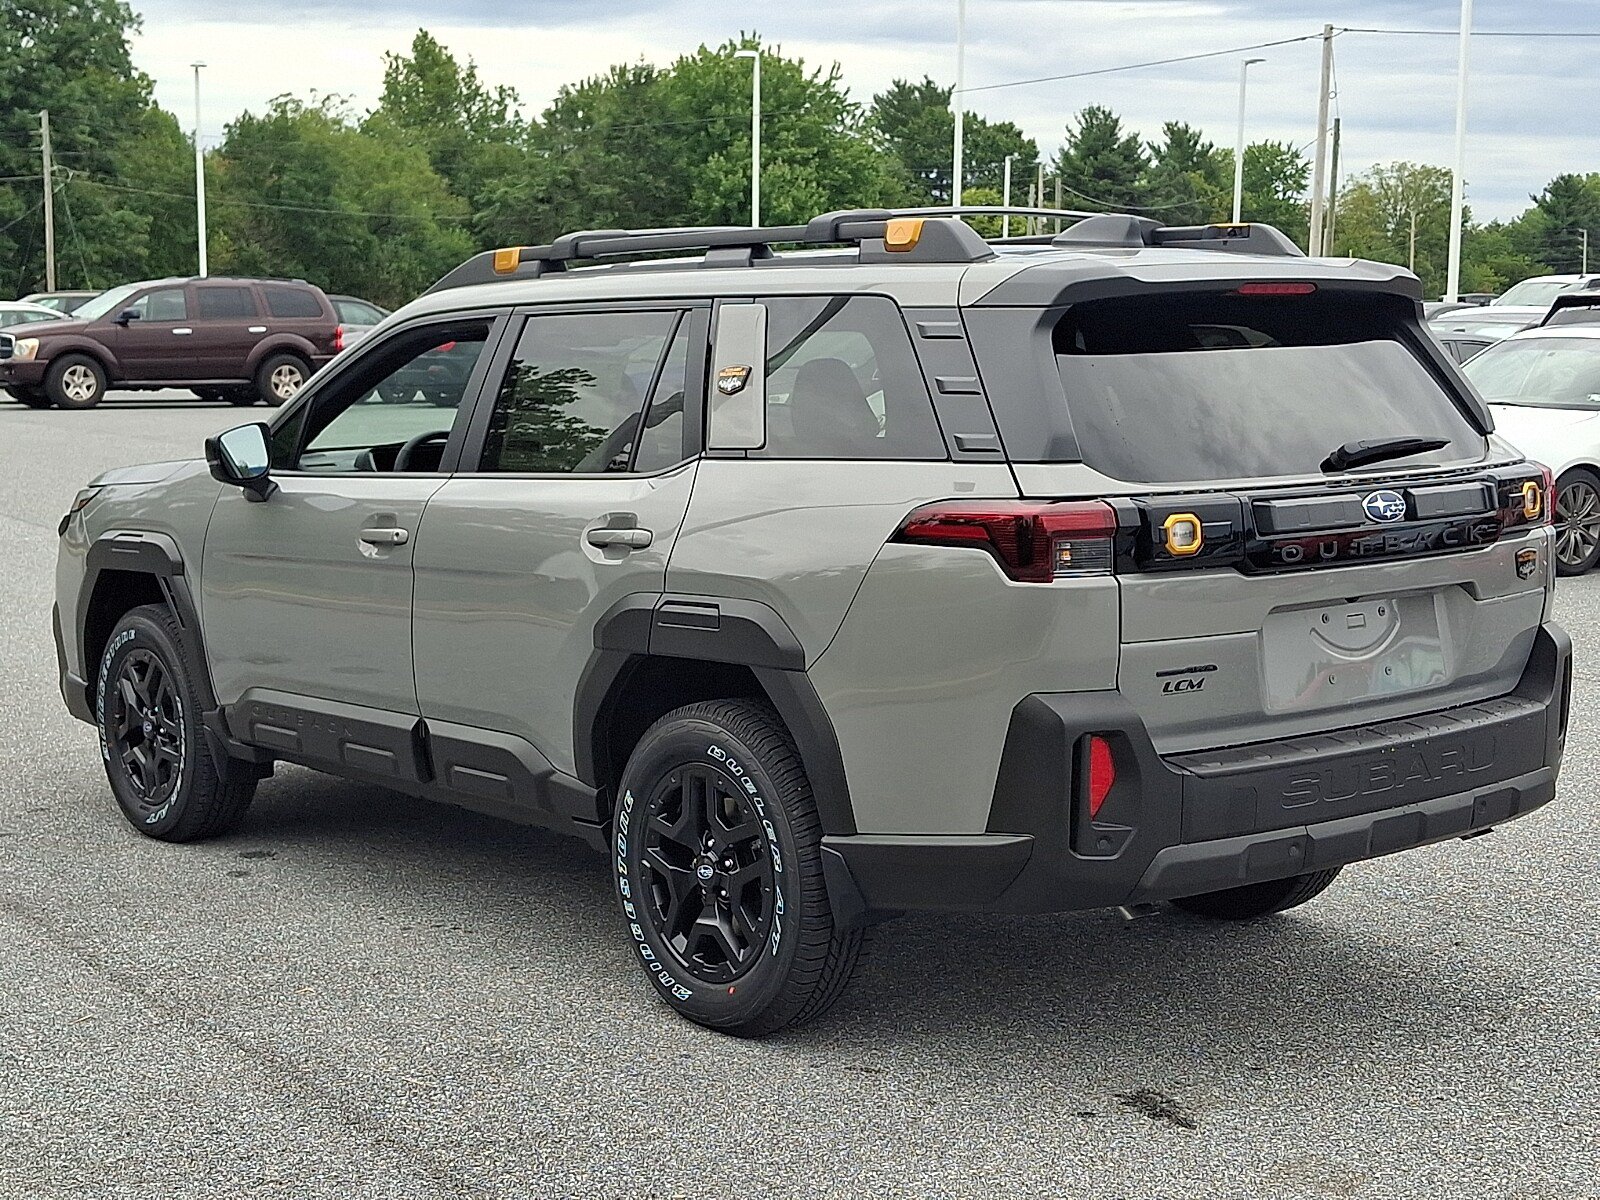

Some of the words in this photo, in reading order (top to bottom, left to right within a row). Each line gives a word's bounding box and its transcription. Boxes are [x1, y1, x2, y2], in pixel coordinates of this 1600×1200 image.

[1281, 524, 1486, 562] OUTBACK
[1162, 677, 1205, 693] LCM
[1281, 737, 1496, 809] SUBARU
[618, 790, 693, 1000] BRIDGESTONE
